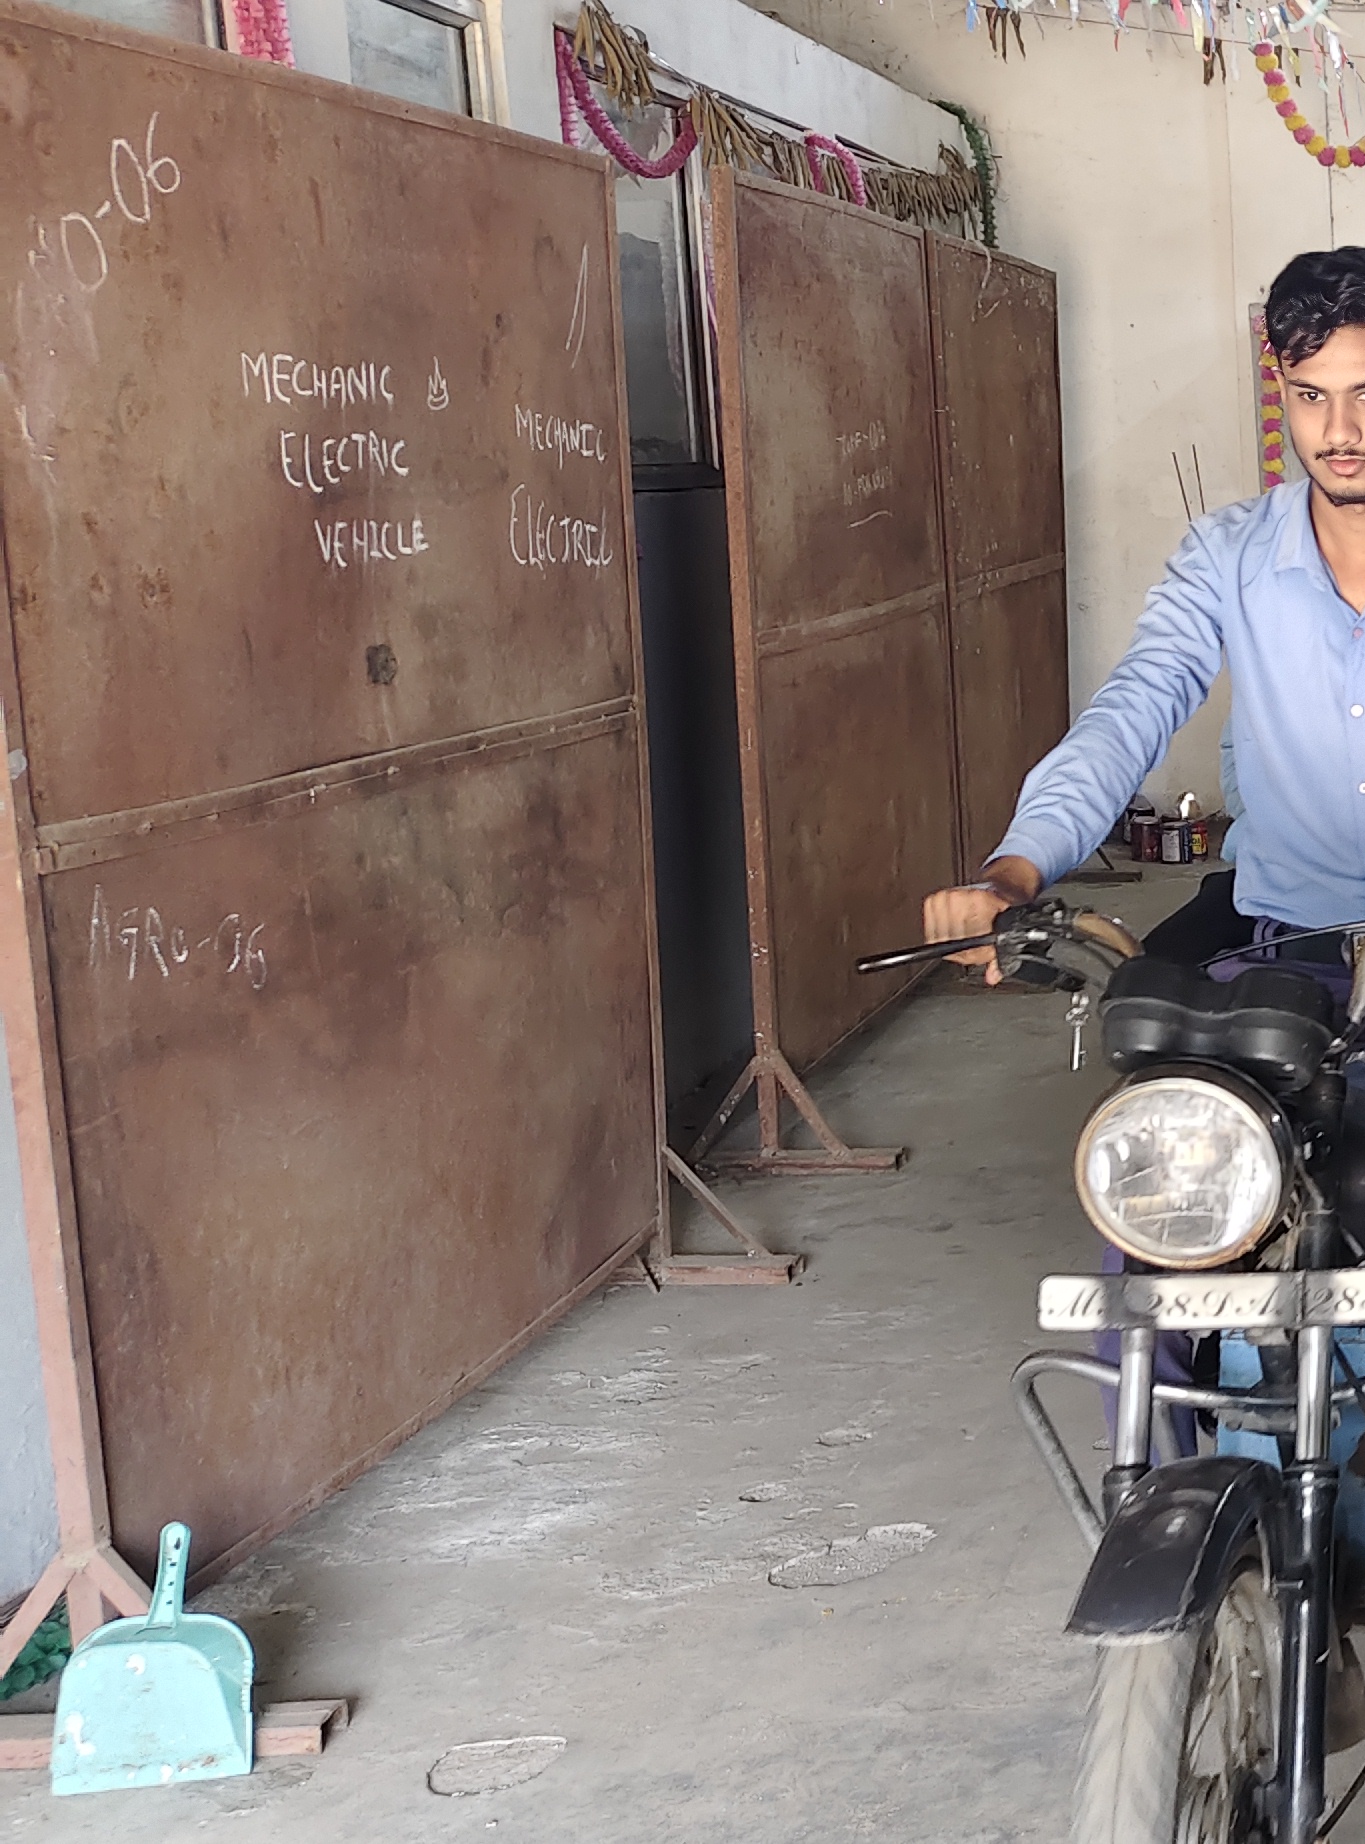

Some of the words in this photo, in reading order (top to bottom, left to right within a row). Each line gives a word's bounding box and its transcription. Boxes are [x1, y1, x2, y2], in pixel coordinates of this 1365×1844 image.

[241, 352, 394, 409] MECHANIC
[280, 430, 410, 493] ELECTRIC
[515, 404, 607, 470] MECHANIC
[314, 517, 430, 567] VEHICLE
